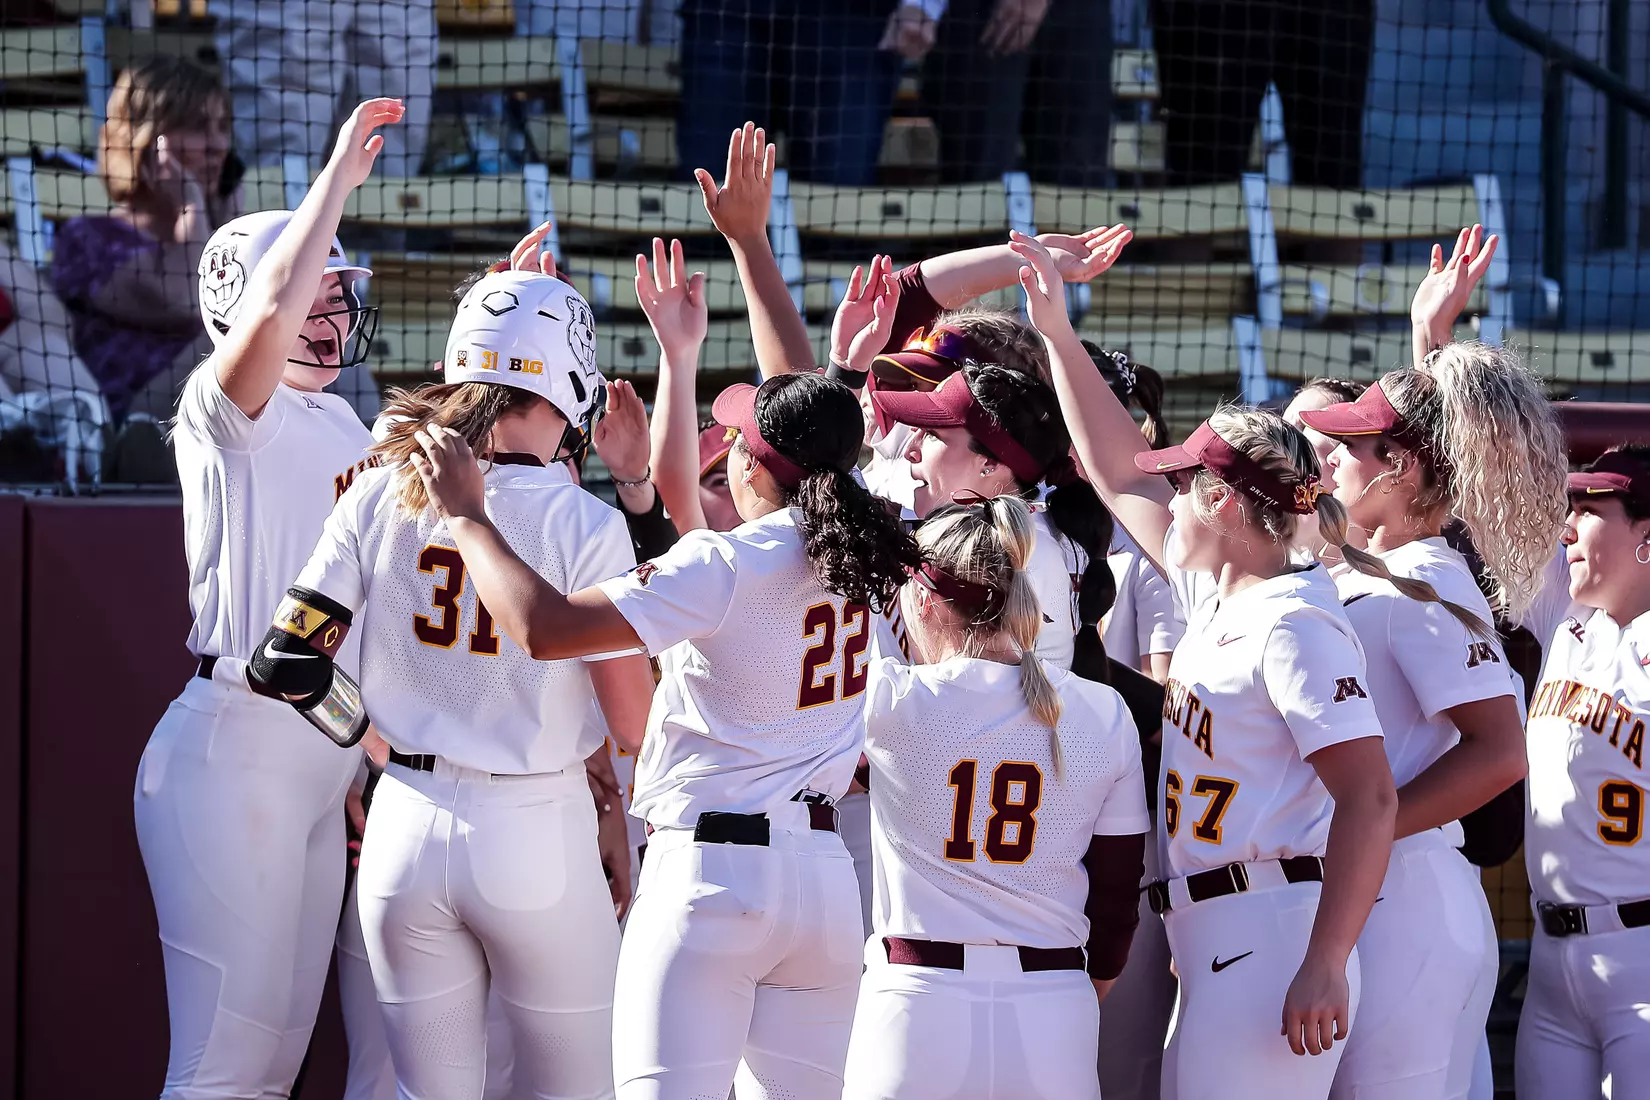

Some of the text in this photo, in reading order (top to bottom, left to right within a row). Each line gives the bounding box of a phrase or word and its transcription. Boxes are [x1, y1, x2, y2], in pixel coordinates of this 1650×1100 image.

[481, 351, 499, 371] 31
[1250, 485, 1279, 506] DRI-FIT
[796, 600, 869, 711] 22
[1465, 642, 1501, 669] M
[1332, 676, 1368, 703] M
[943, 758, 1044, 865] 18
[1164, 768, 1241, 846] 67
[1597, 779, 1645, 848] 9
